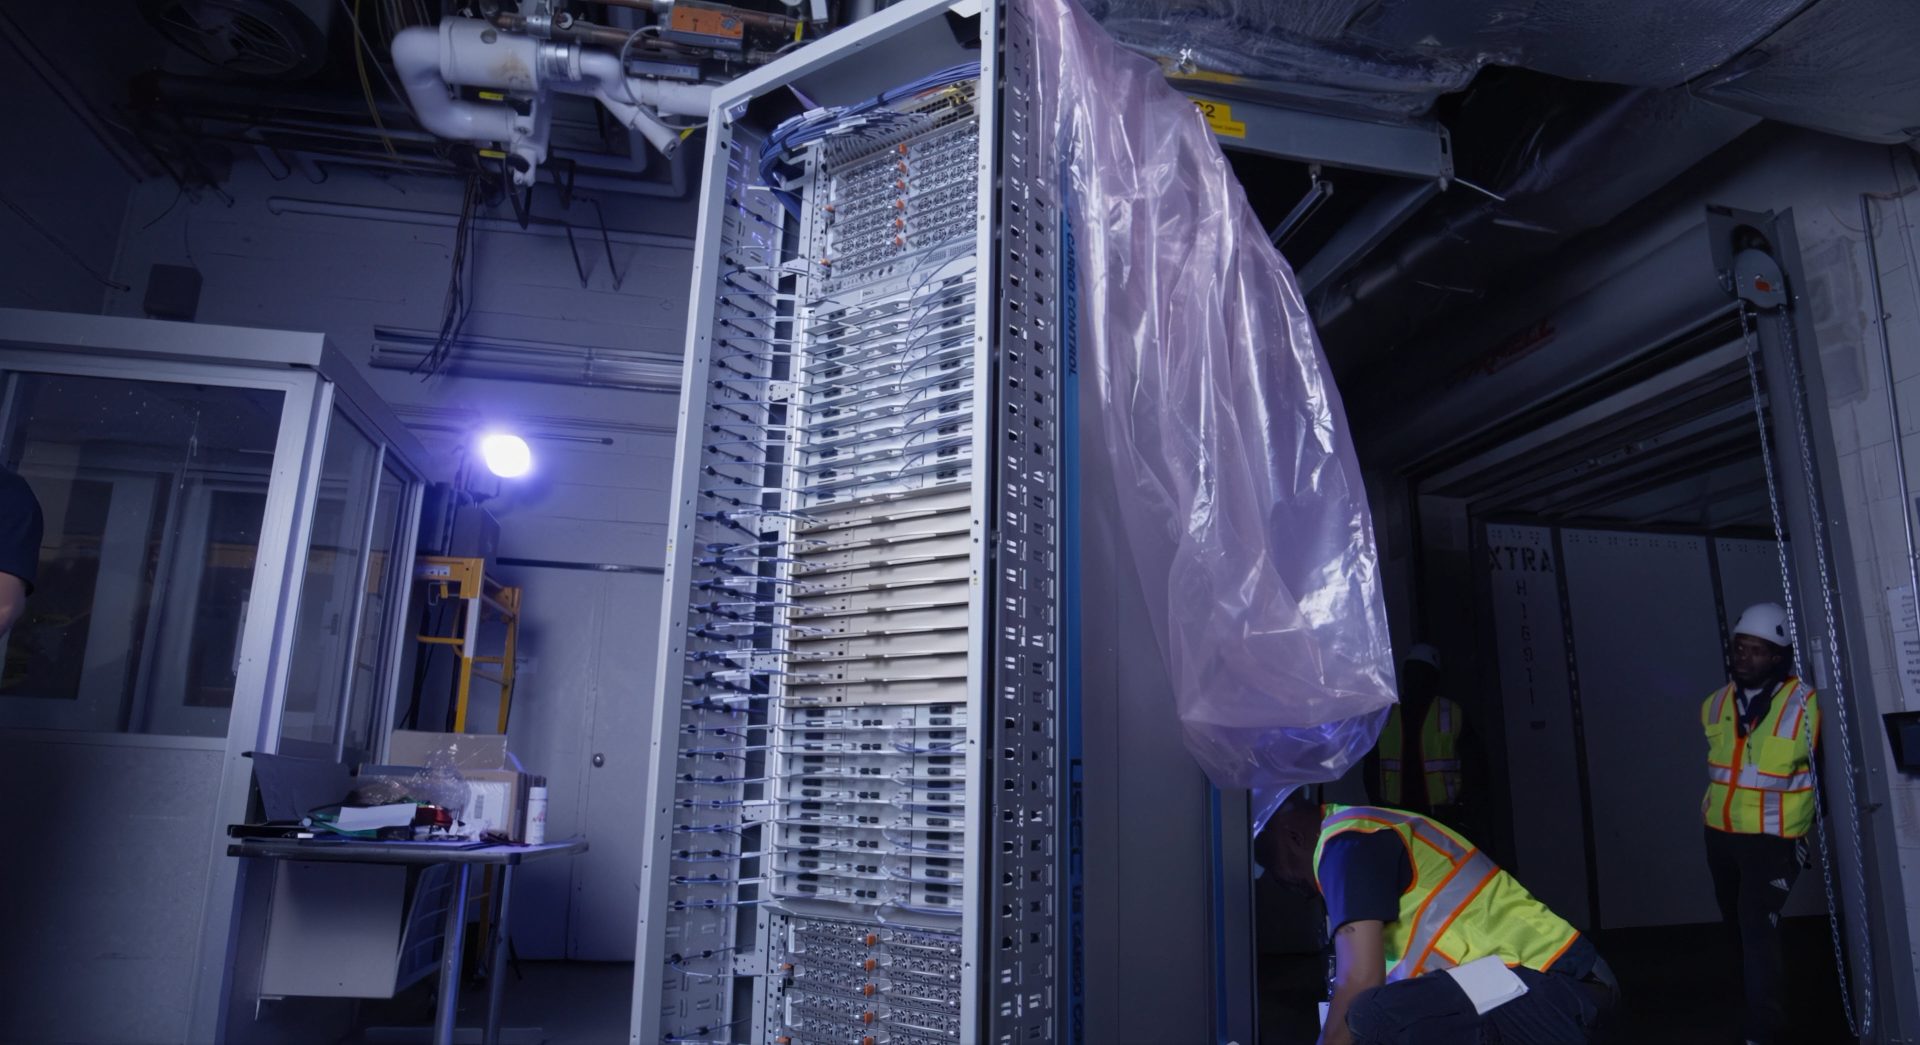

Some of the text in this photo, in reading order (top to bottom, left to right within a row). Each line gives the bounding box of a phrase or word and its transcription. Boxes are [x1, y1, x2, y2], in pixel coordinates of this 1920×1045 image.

[1066, 232, 1076, 293] CARGO
[1067, 295, 1077, 376] CONTROL
[1488, 546, 1554, 573] XTRA
